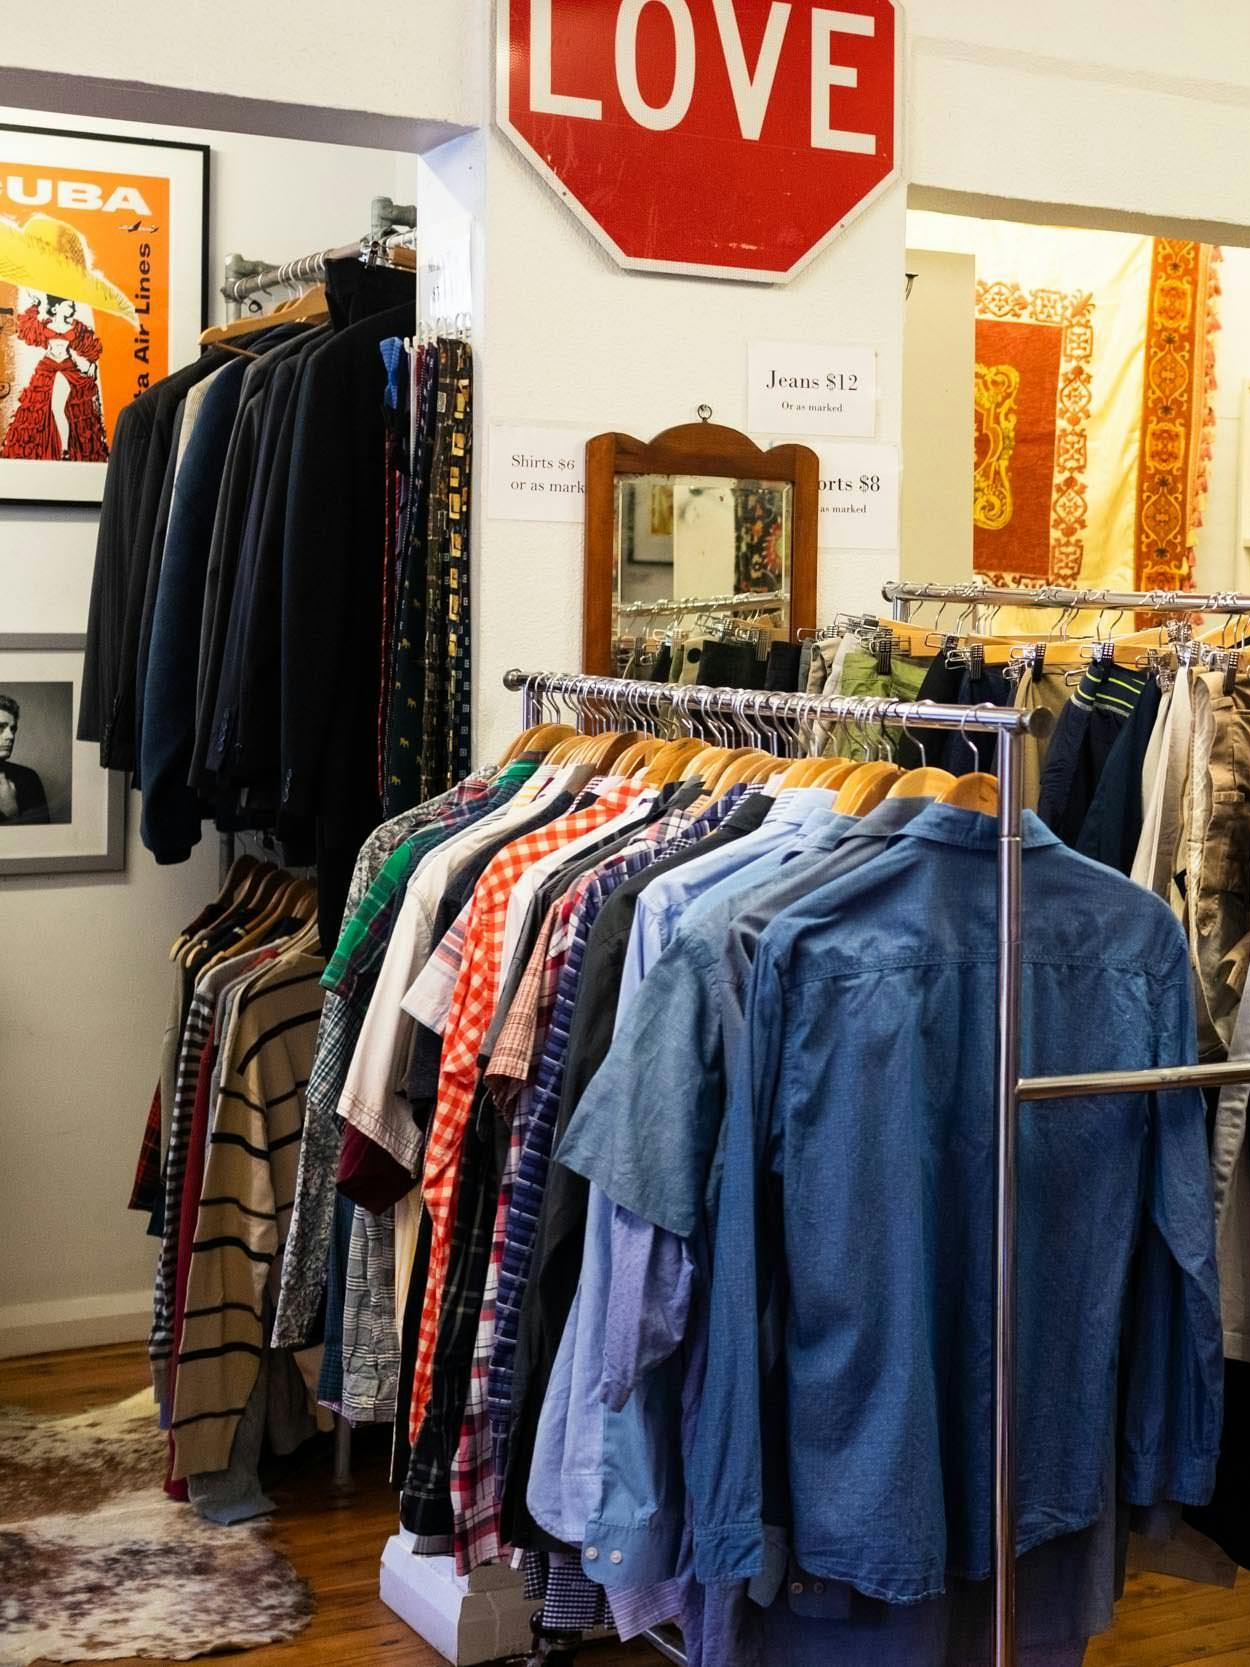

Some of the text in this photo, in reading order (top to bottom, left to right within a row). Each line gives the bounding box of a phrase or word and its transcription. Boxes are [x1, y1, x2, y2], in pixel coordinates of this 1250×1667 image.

[530, 0, 877, 155] LOVE
[0, 175, 153, 216] UBA
[134, 243, 151, 315] Lines
[134, 323, 150, 365] Air
[765, 369, 858, 391] Jeans $12
[781, 401, 794, 410] Or
[808, 403, 843, 412] marked
[511, 454, 576, 471] Shirts $6
[510, 480, 585, 494] or as mark
[818, 474, 880, 493] orts $8
[832, 504, 867, 513] marked
